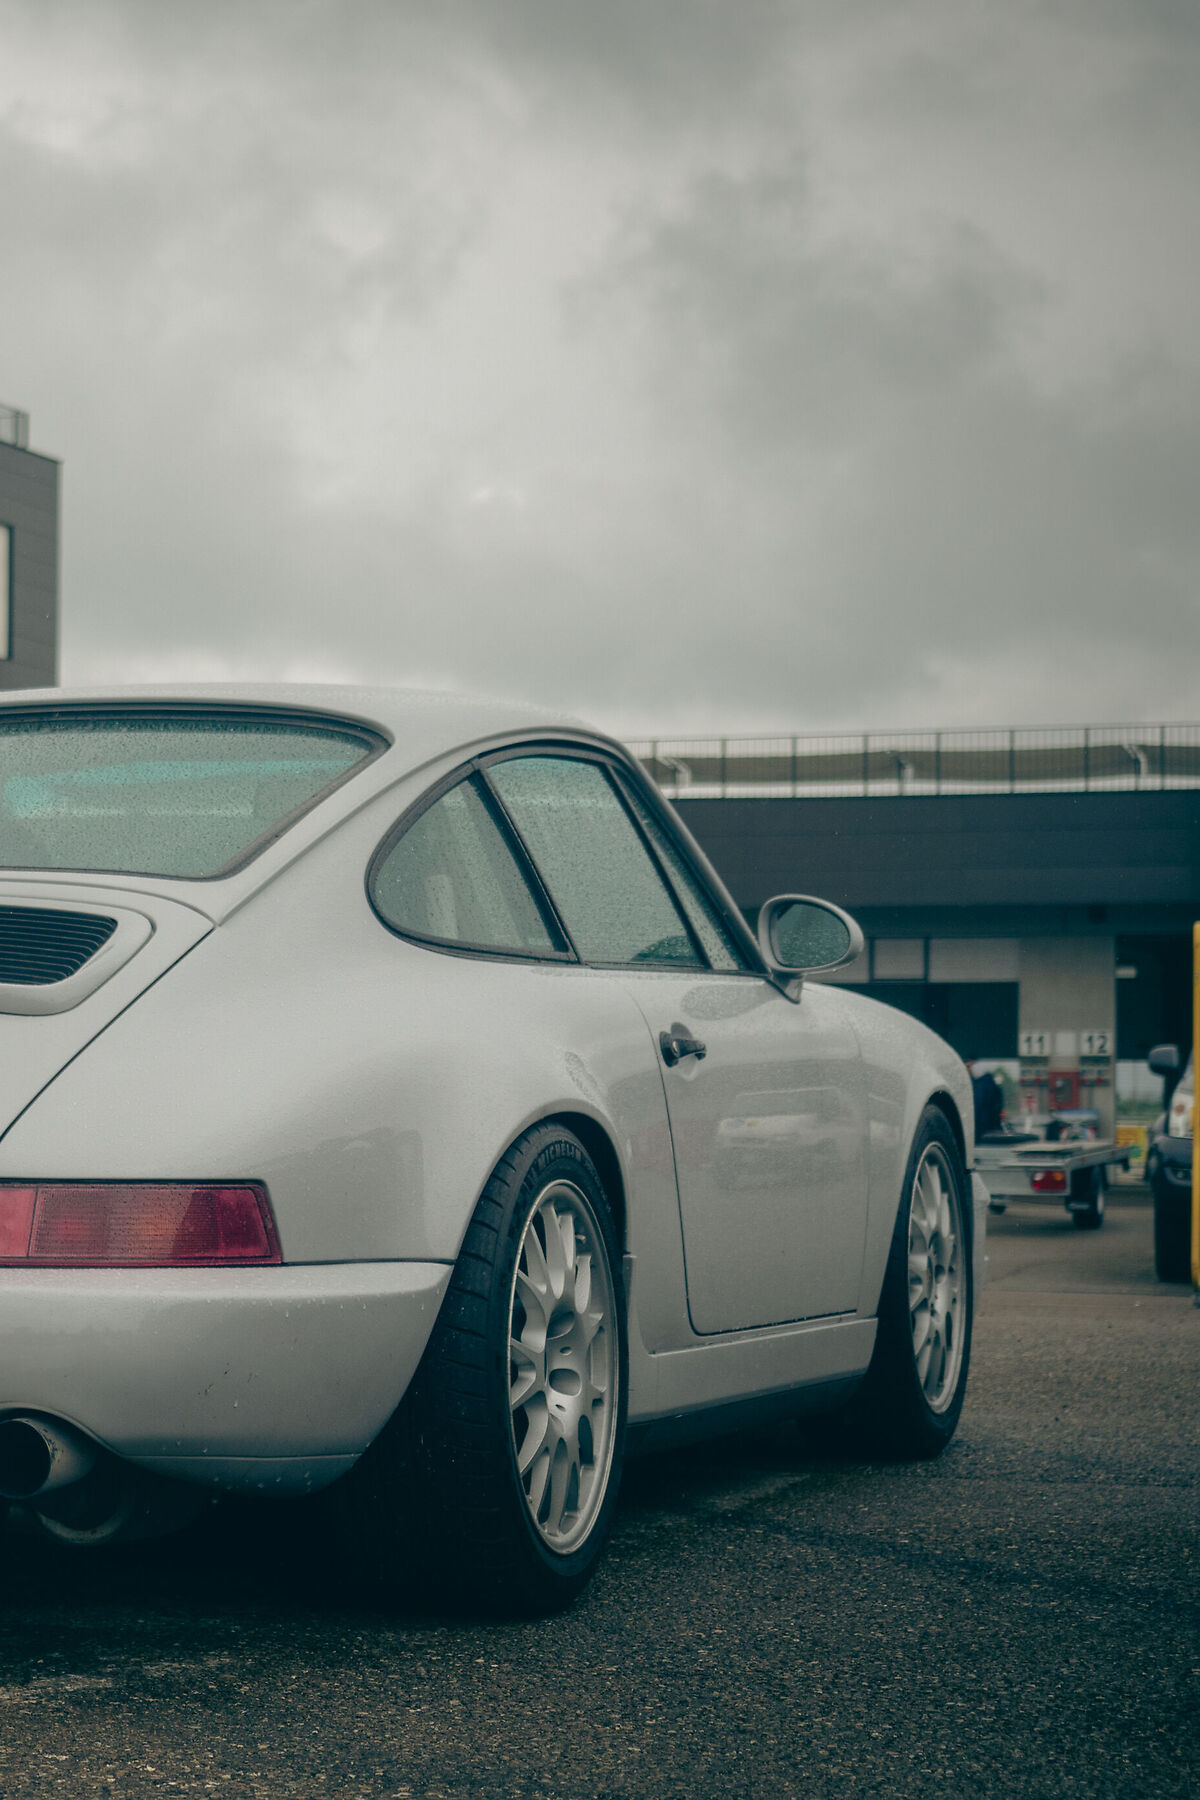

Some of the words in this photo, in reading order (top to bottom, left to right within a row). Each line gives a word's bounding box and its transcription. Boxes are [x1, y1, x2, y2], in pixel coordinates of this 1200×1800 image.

[1024, 1035, 1044, 1054] 11
[1087, 1035, 1107, 1054] 12
[538, 1143, 583, 1169] MICHELIN
